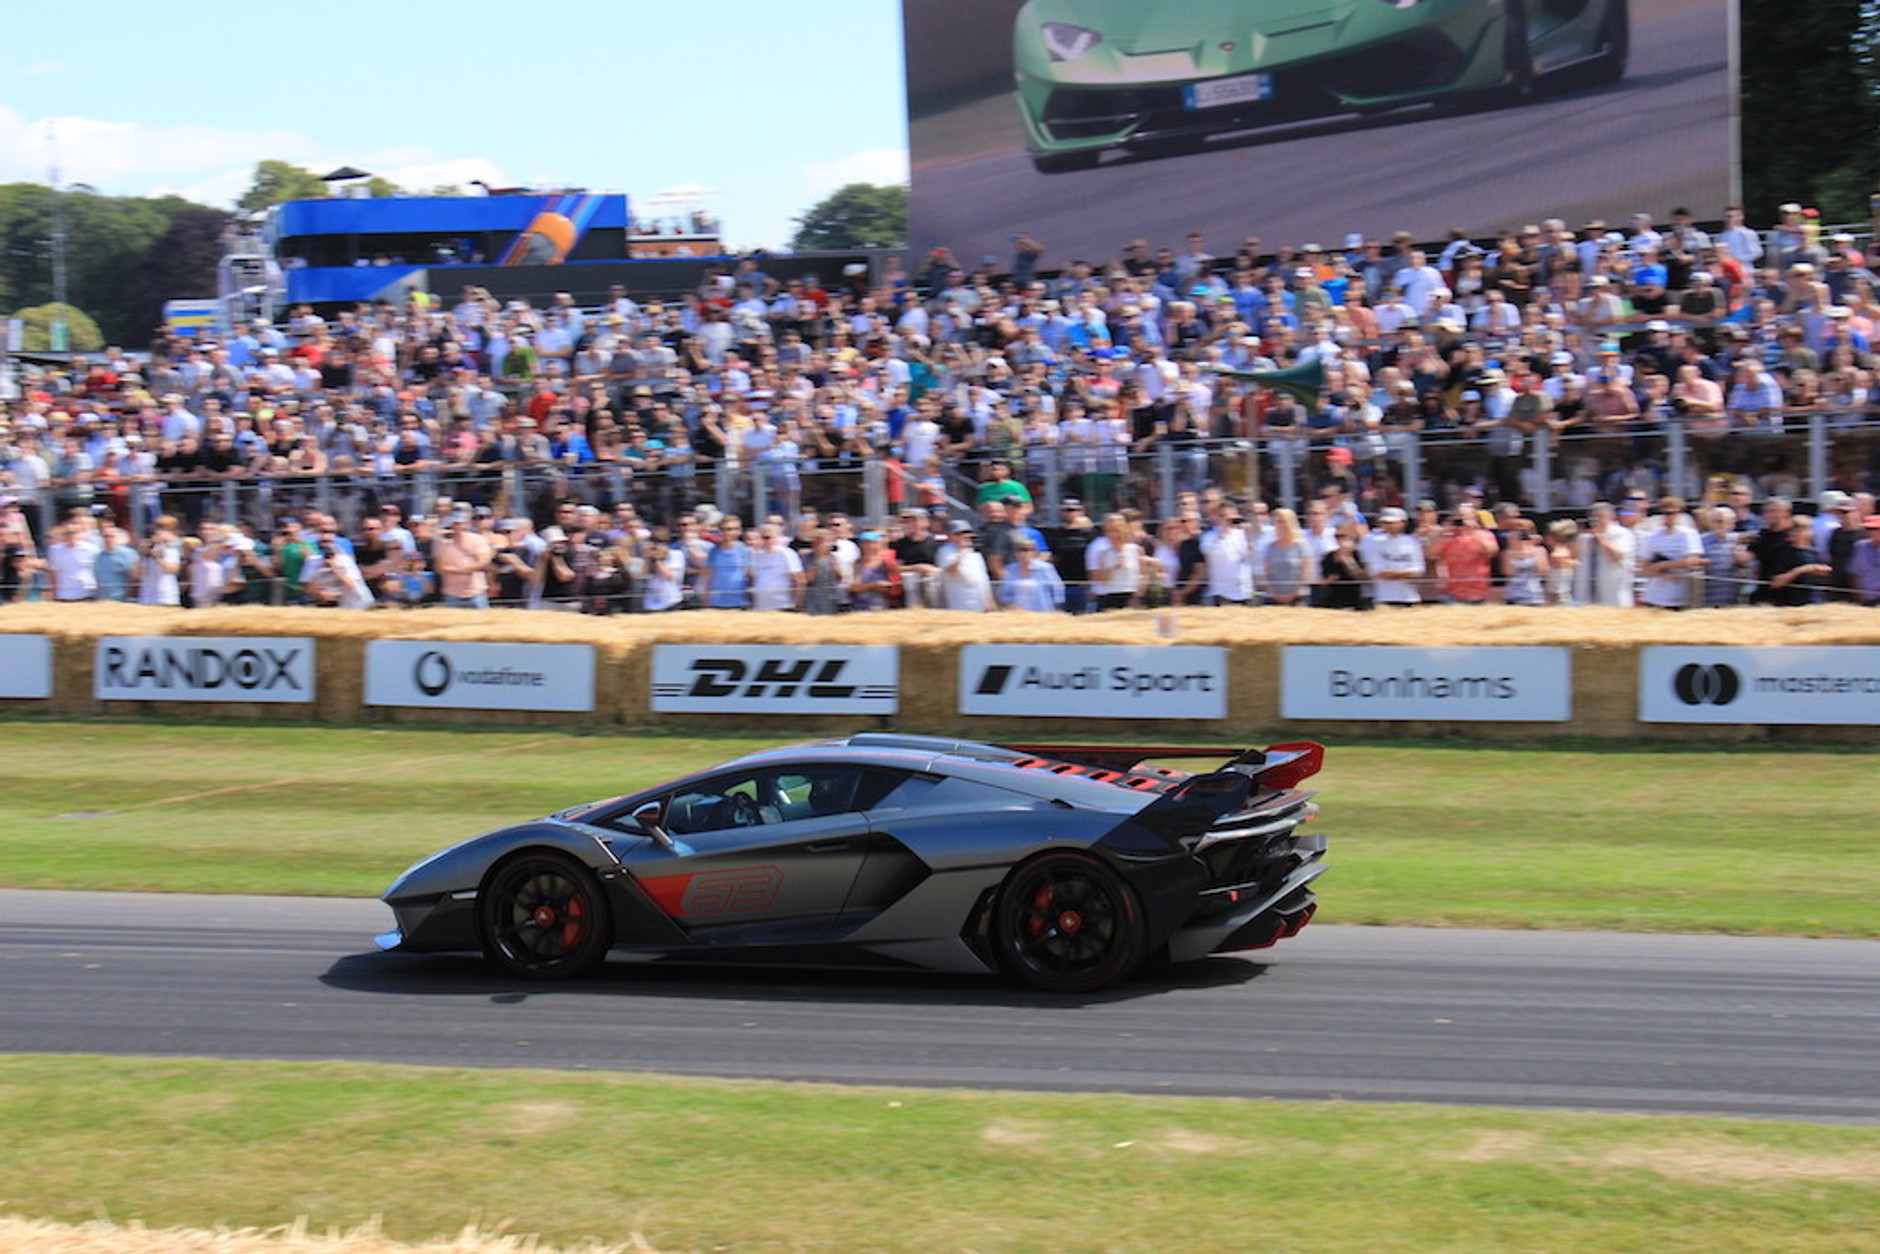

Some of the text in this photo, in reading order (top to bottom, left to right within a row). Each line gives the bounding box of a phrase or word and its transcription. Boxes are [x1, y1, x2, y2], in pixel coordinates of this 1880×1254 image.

[104, 647, 302, 689] RANDOX
[458, 667, 545, 686] vodafone
[688, 659, 856, 697] DHL
[1019, 666, 1215, 697] Audi Sport
[1329, 668, 1515, 698] Bonhams
[681, 865, 784, 916] 63
